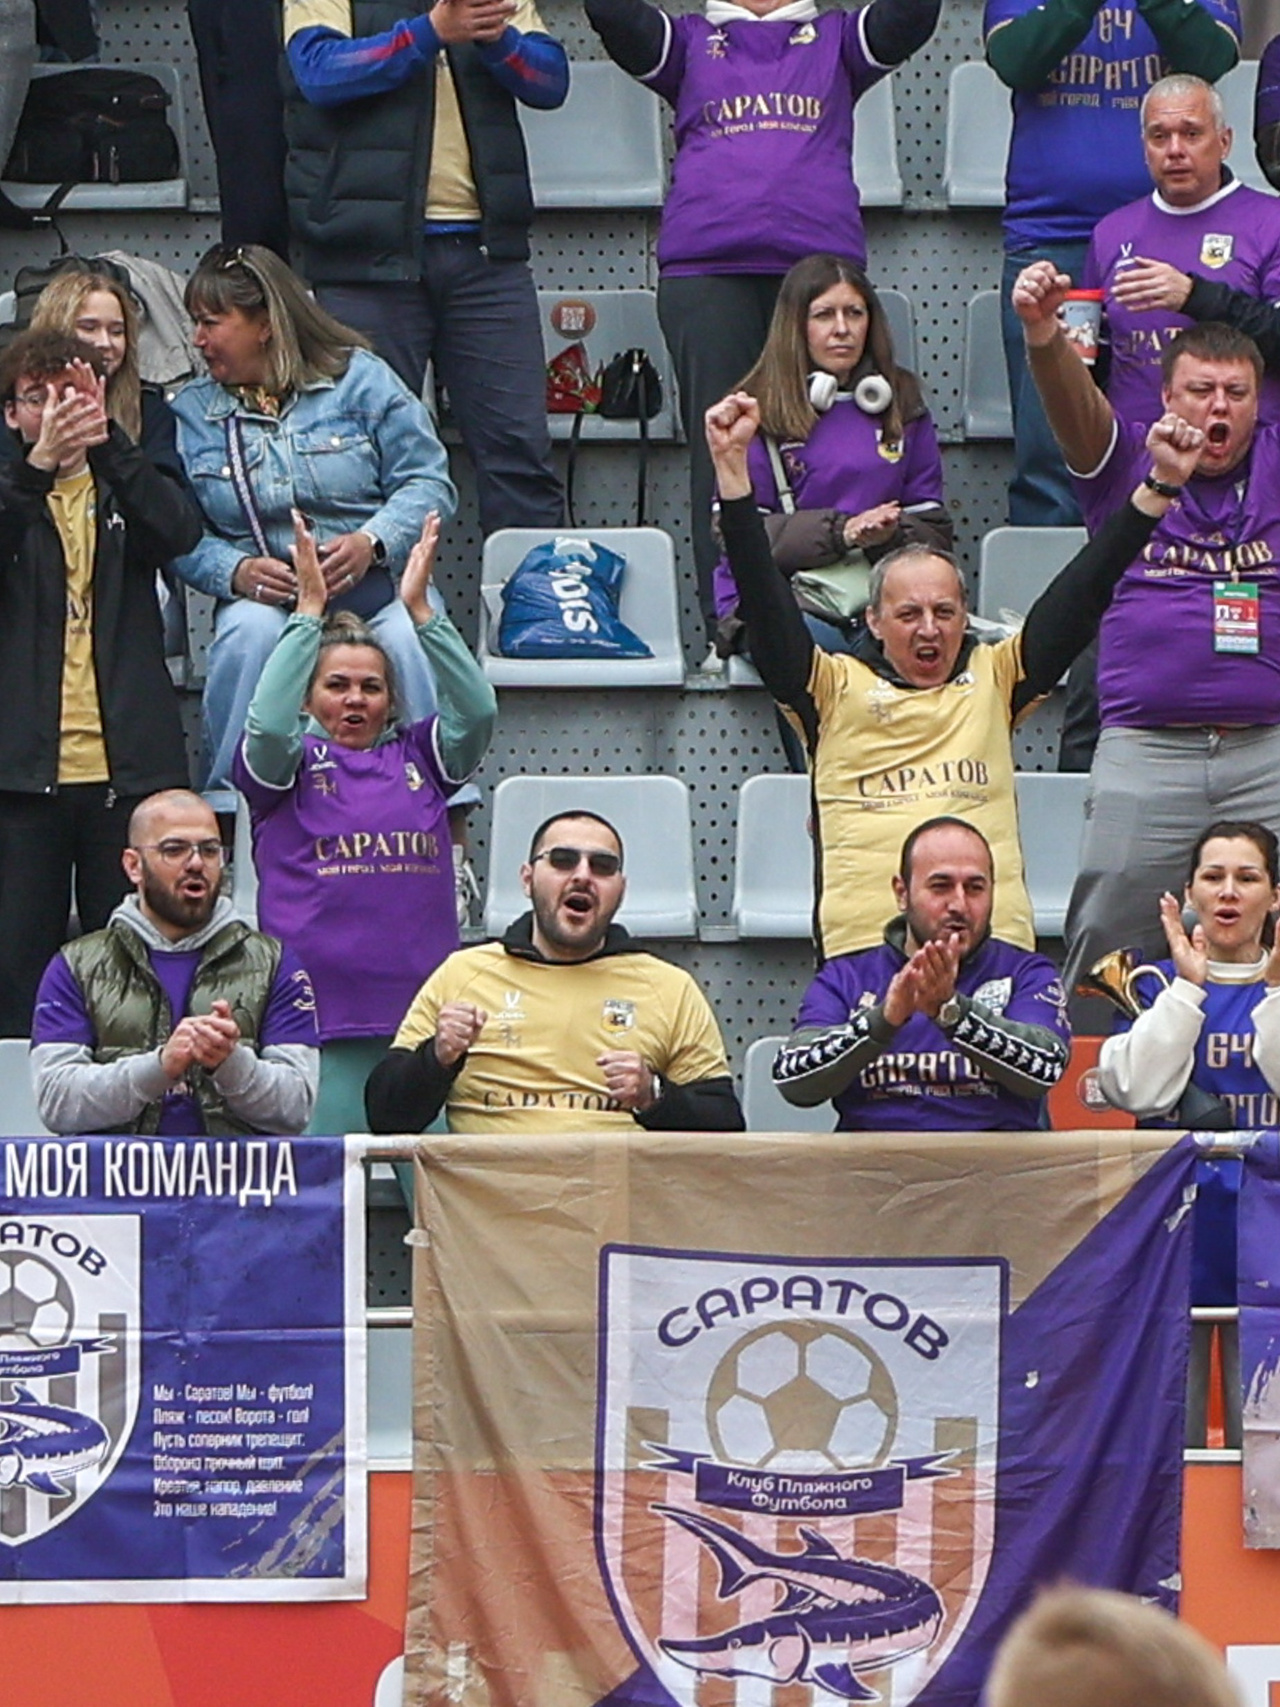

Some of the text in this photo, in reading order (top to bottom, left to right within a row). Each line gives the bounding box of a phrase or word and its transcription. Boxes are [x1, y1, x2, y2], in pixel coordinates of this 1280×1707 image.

[1099, 8, 1133, 42] 64
[858, 758, 989, 798] САРАТОВ
[315, 831, 440, 862] САРАТОВ
[1207, 1032, 1252, 1069] 64
[5, 1141, 298, 1208] МОЯ КОМАНДА
[0, 1221, 108, 1277] АТОВ
[657, 1274, 950, 1361] САРАТОВ
[153, 1384, 174, 1401] Мы
[236, 1384, 256, 1401] Мы
[153, 1431, 185, 1450] Пусть
[726, 1471, 873, 1494] Клуб Пляжного
[153, 1501, 172, 1517] Это
[751, 1493, 848, 1512] Футбола
